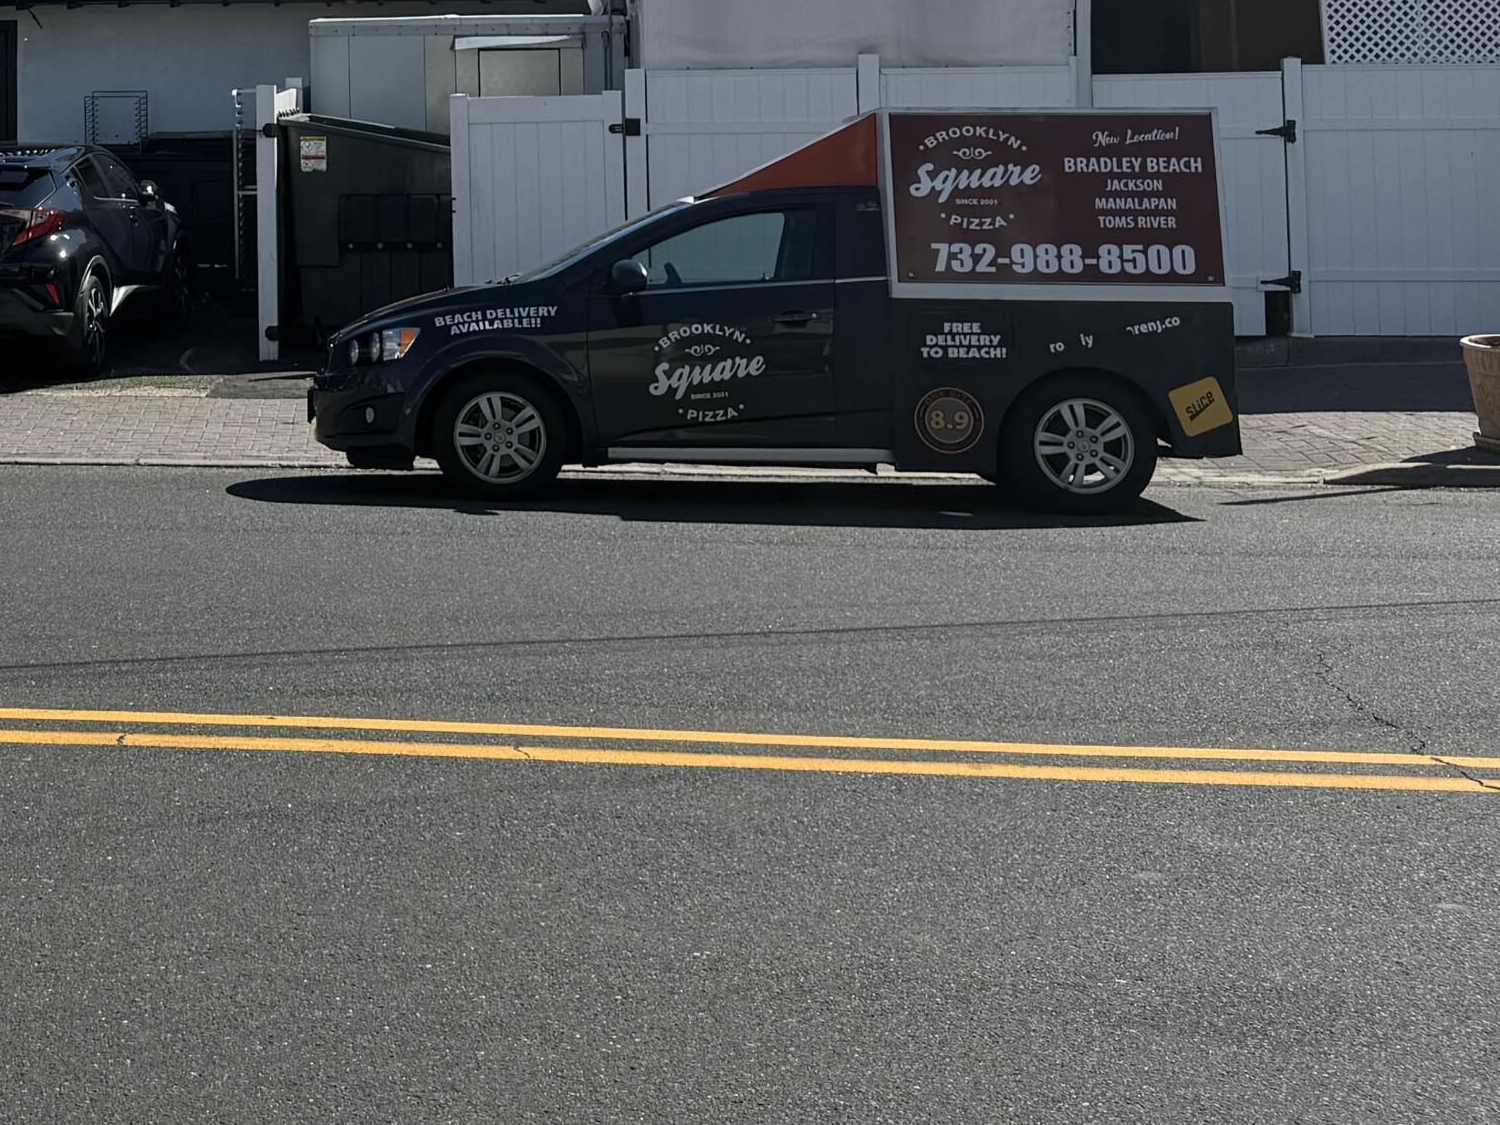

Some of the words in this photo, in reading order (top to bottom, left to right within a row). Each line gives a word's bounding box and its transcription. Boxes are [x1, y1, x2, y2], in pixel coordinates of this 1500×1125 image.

[924, 125, 1021, 150] BROOKLYN
[1125, 127, 1179, 145] Location!
[1063, 157, 1143, 173] BRADLEY
[1147, 157, 1203, 173] BEACH
[909, 163, 1042, 203] Square
[1105, 179, 1163, 192] JACKSON
[1095, 198, 1177, 210] MANALAPAN
[949, 214, 1008, 230] PIZZA
[1098, 216, 1136, 229] TOMS
[1138, 216, 1177, 229] RIVER
[931, 242, 1197, 275] 732-988-8500
[435, 311, 482, 328] BEACH
[486, 306, 557, 319] DELIVERY
[450, 319, 541, 335] AVAILABLE!!
[943, 322, 981, 334] FREE
[658, 323, 746, 348] BROOKLYN
[925, 334, 1001, 346] DELIVERY
[920, 347, 944, 358] TO
[948, 347, 1007, 359] BEACH!
[648, 355, 766, 400] Square
[687, 407, 739, 422] PIZZA
[930, 410, 970, 429] 8.9
